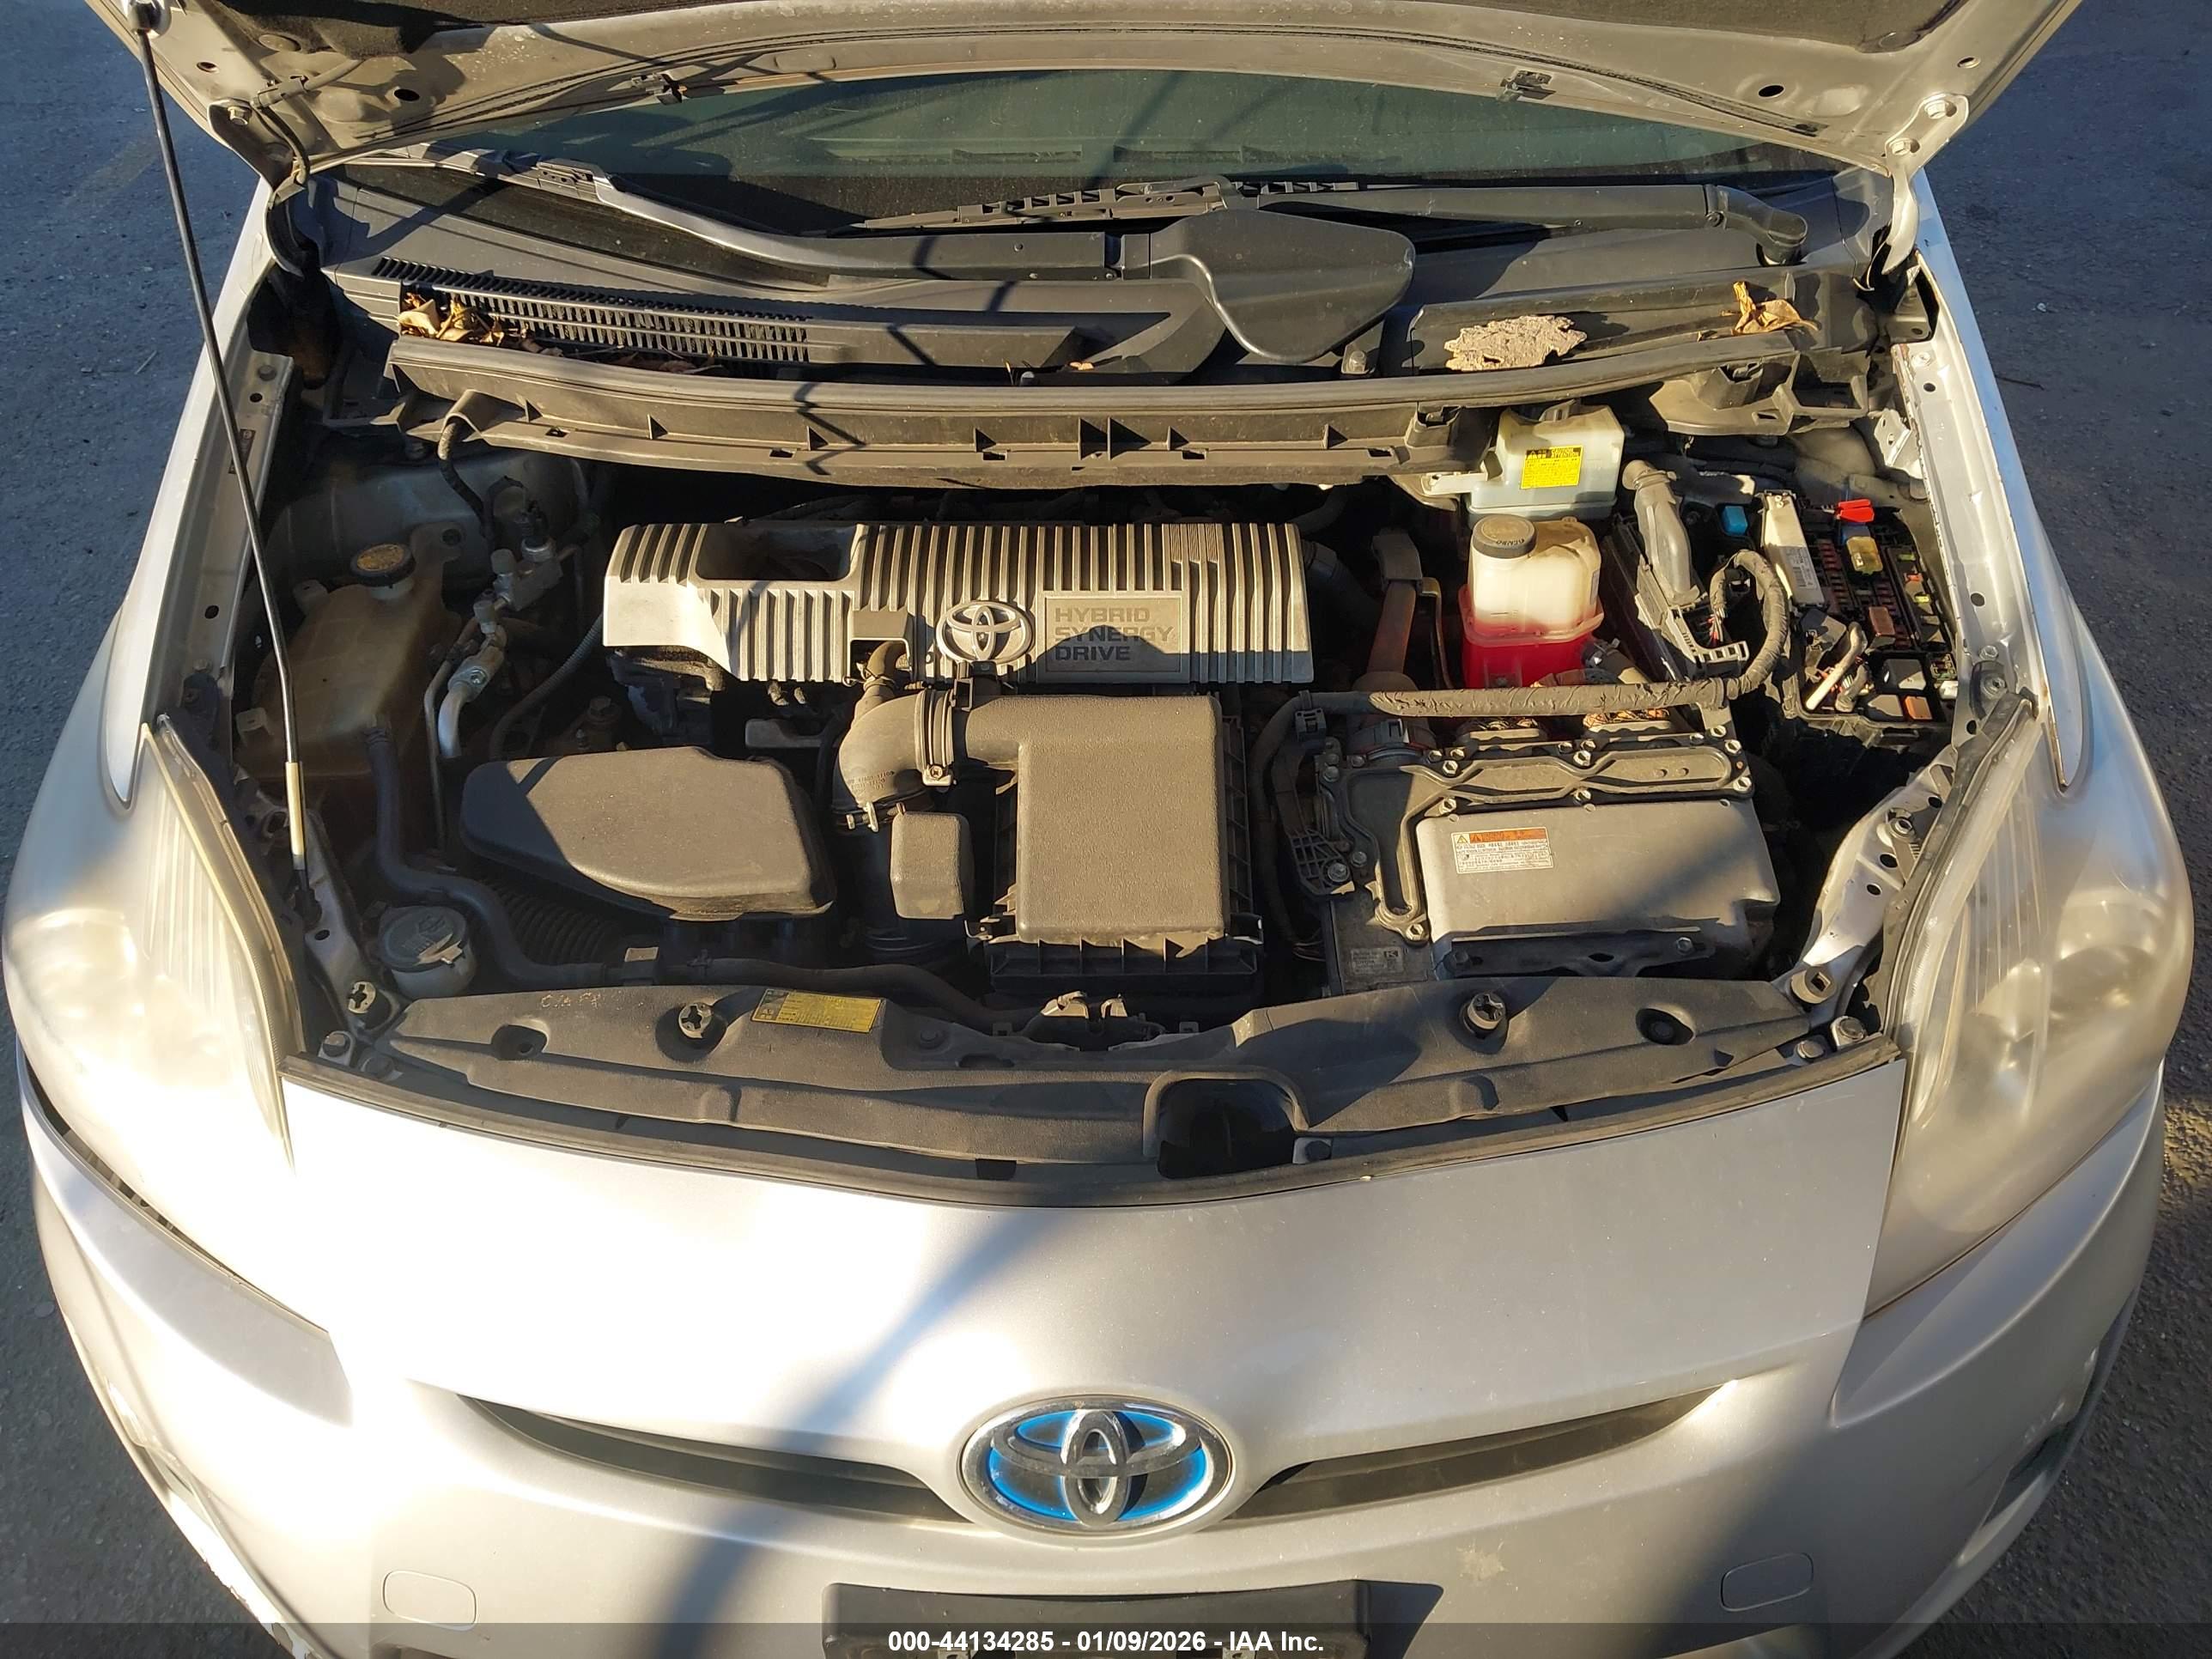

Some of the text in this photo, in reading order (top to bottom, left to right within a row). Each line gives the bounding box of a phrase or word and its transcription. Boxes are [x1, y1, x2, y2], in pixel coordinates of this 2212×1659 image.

[1054, 607, 1151, 623] HYBRID
[1054, 626, 1174, 641] SYNERGY
[1054, 646, 1131, 660] DRIVE
